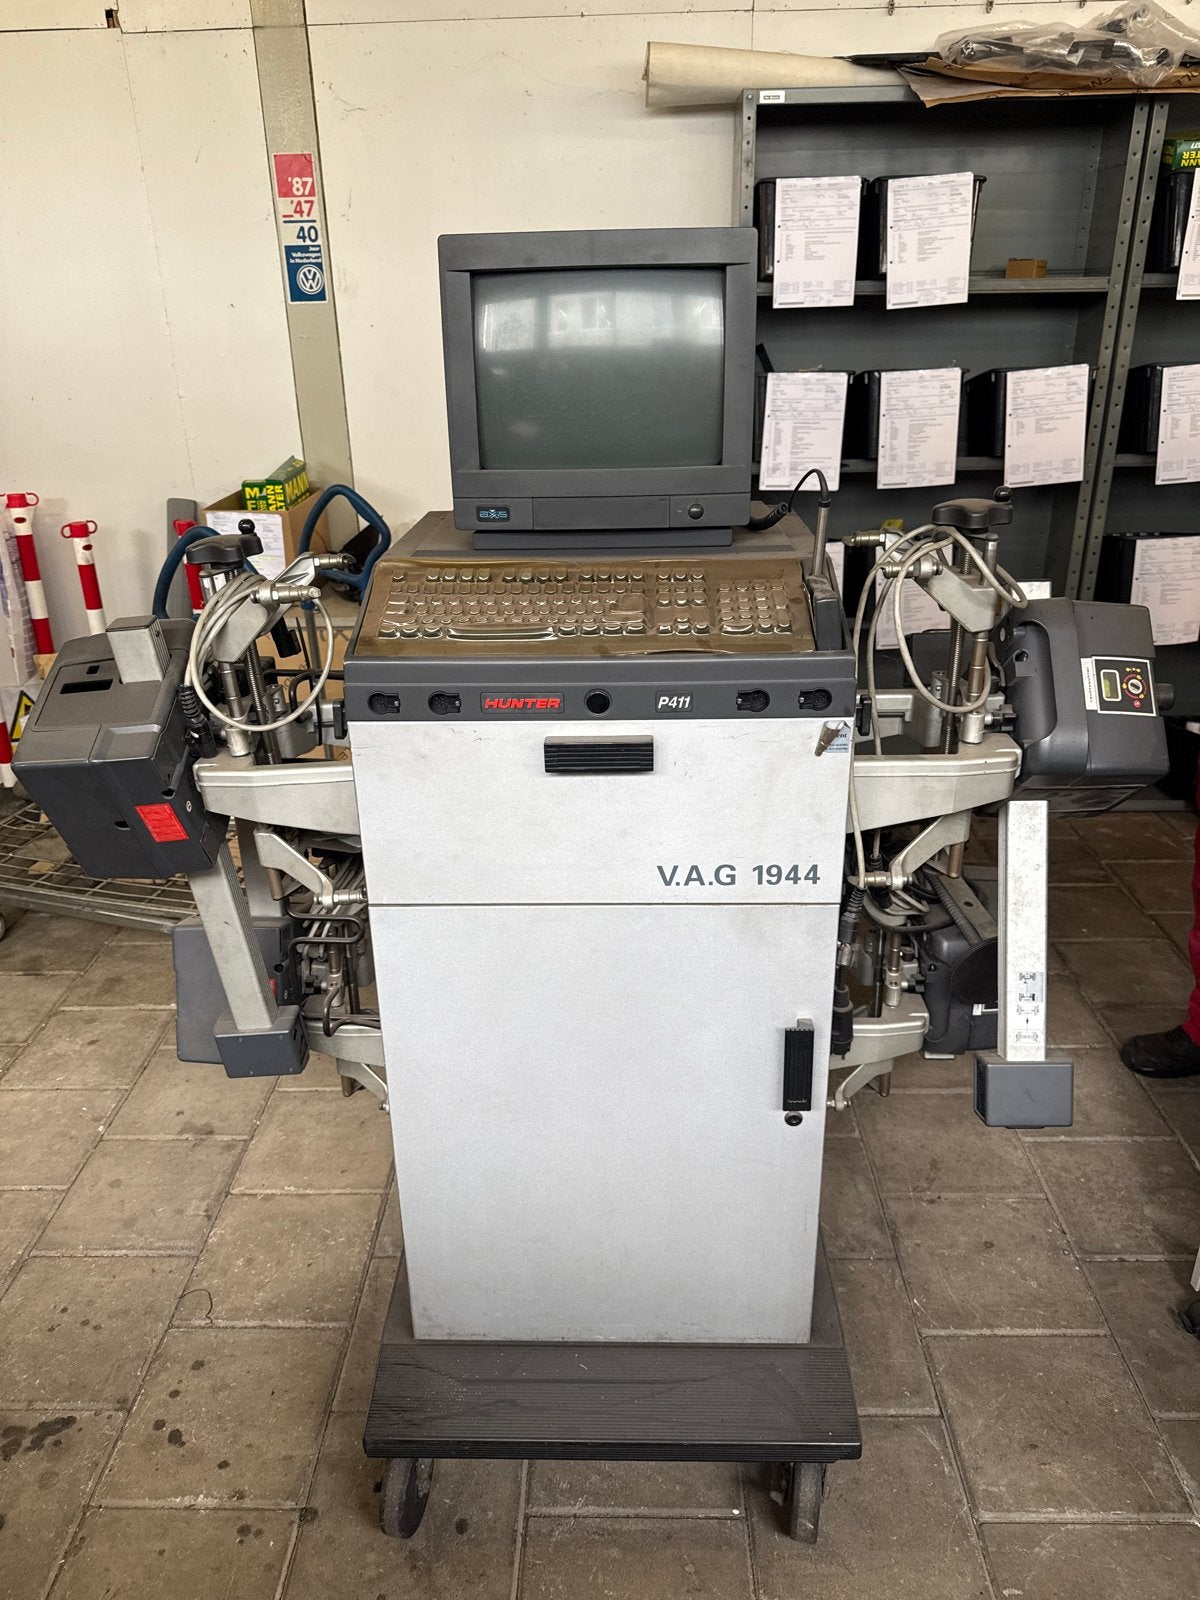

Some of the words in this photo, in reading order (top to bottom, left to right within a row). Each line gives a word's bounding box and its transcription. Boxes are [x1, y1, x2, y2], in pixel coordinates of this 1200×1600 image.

[296, 225, 319, 243] 40
[484, 697, 562, 709] HUNTER
[657, 695, 692, 709] P411
[656, 864, 737, 886] V.A.G
[752, 864, 821, 885] 1944
